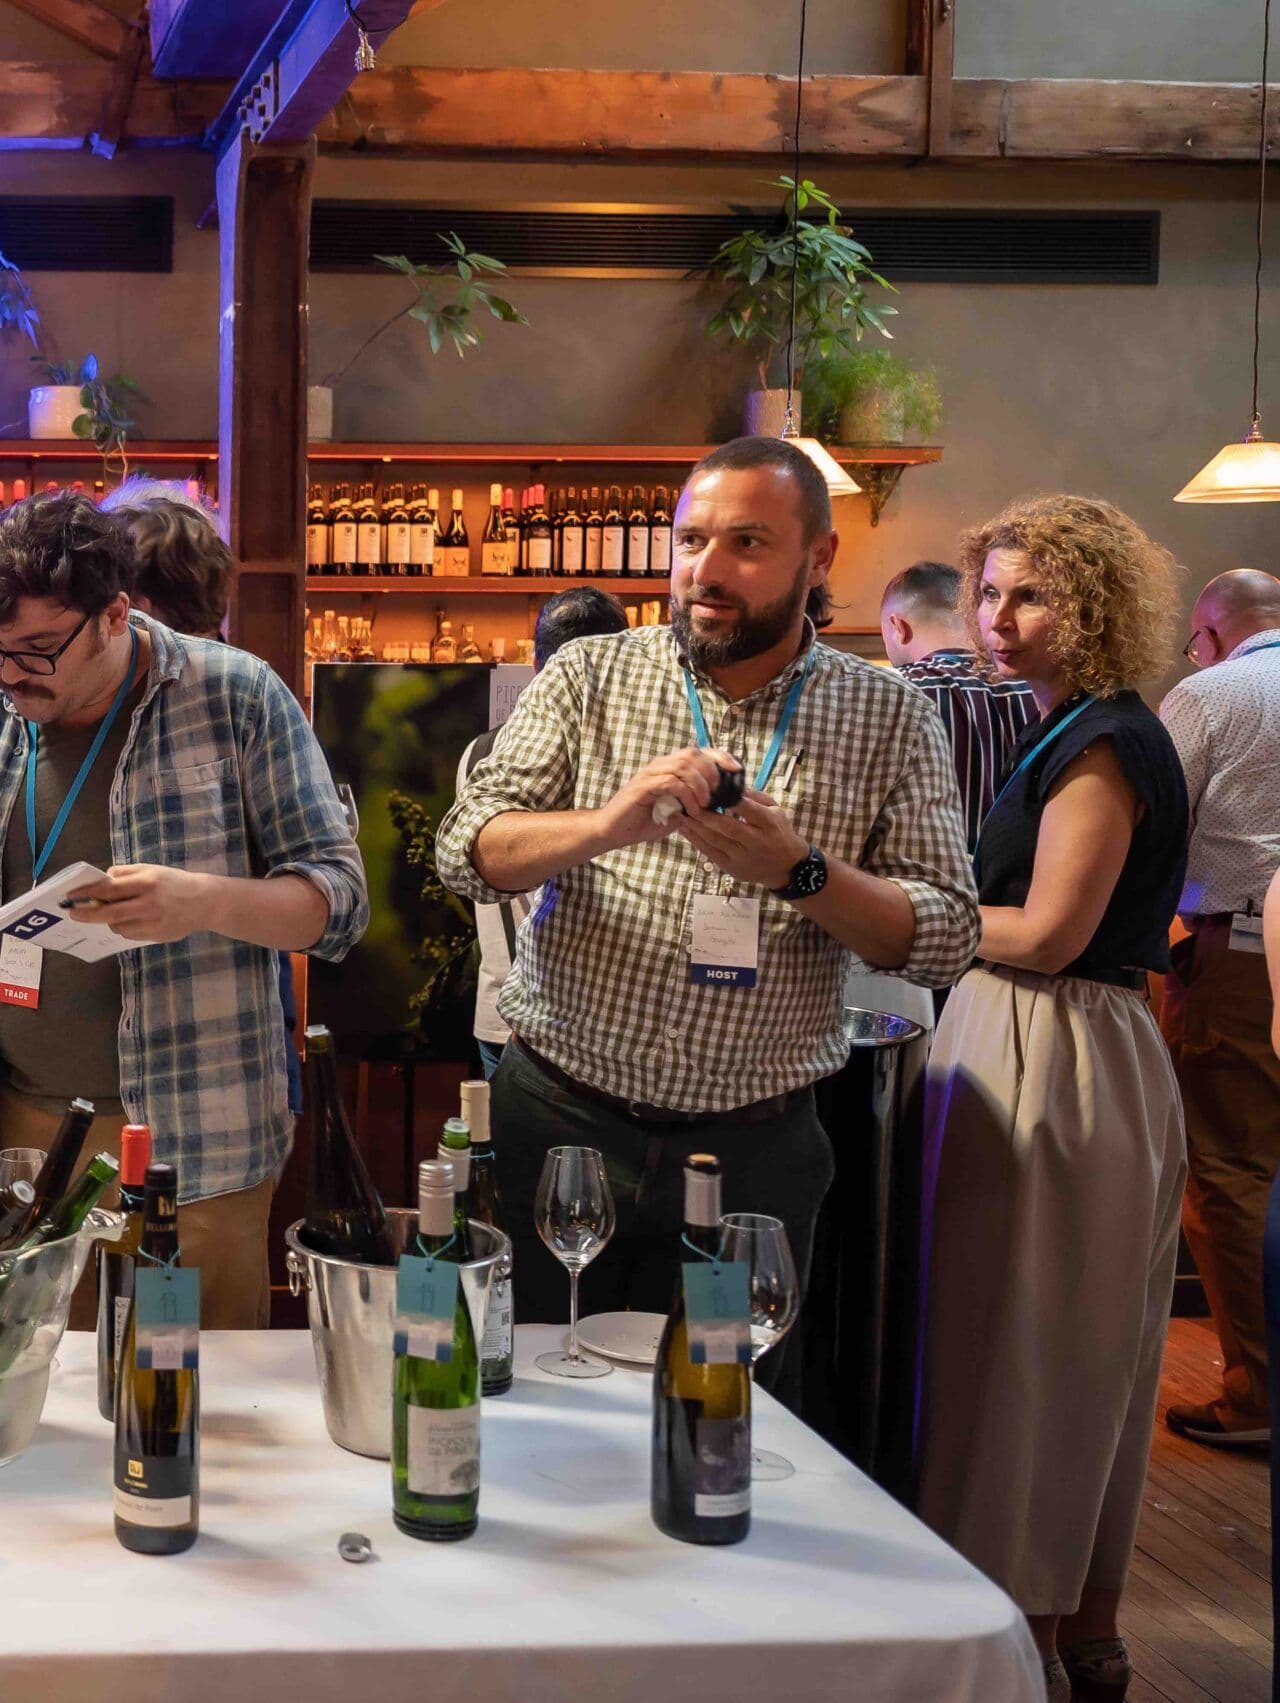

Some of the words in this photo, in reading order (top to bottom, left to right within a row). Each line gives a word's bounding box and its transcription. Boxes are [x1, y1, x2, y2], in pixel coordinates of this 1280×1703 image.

[496, 684, 524, 704] PICP
[14, 914, 49, 933] 16
[706, 969, 739, 980] HOST
[4, 988, 29, 1001] TRADE
